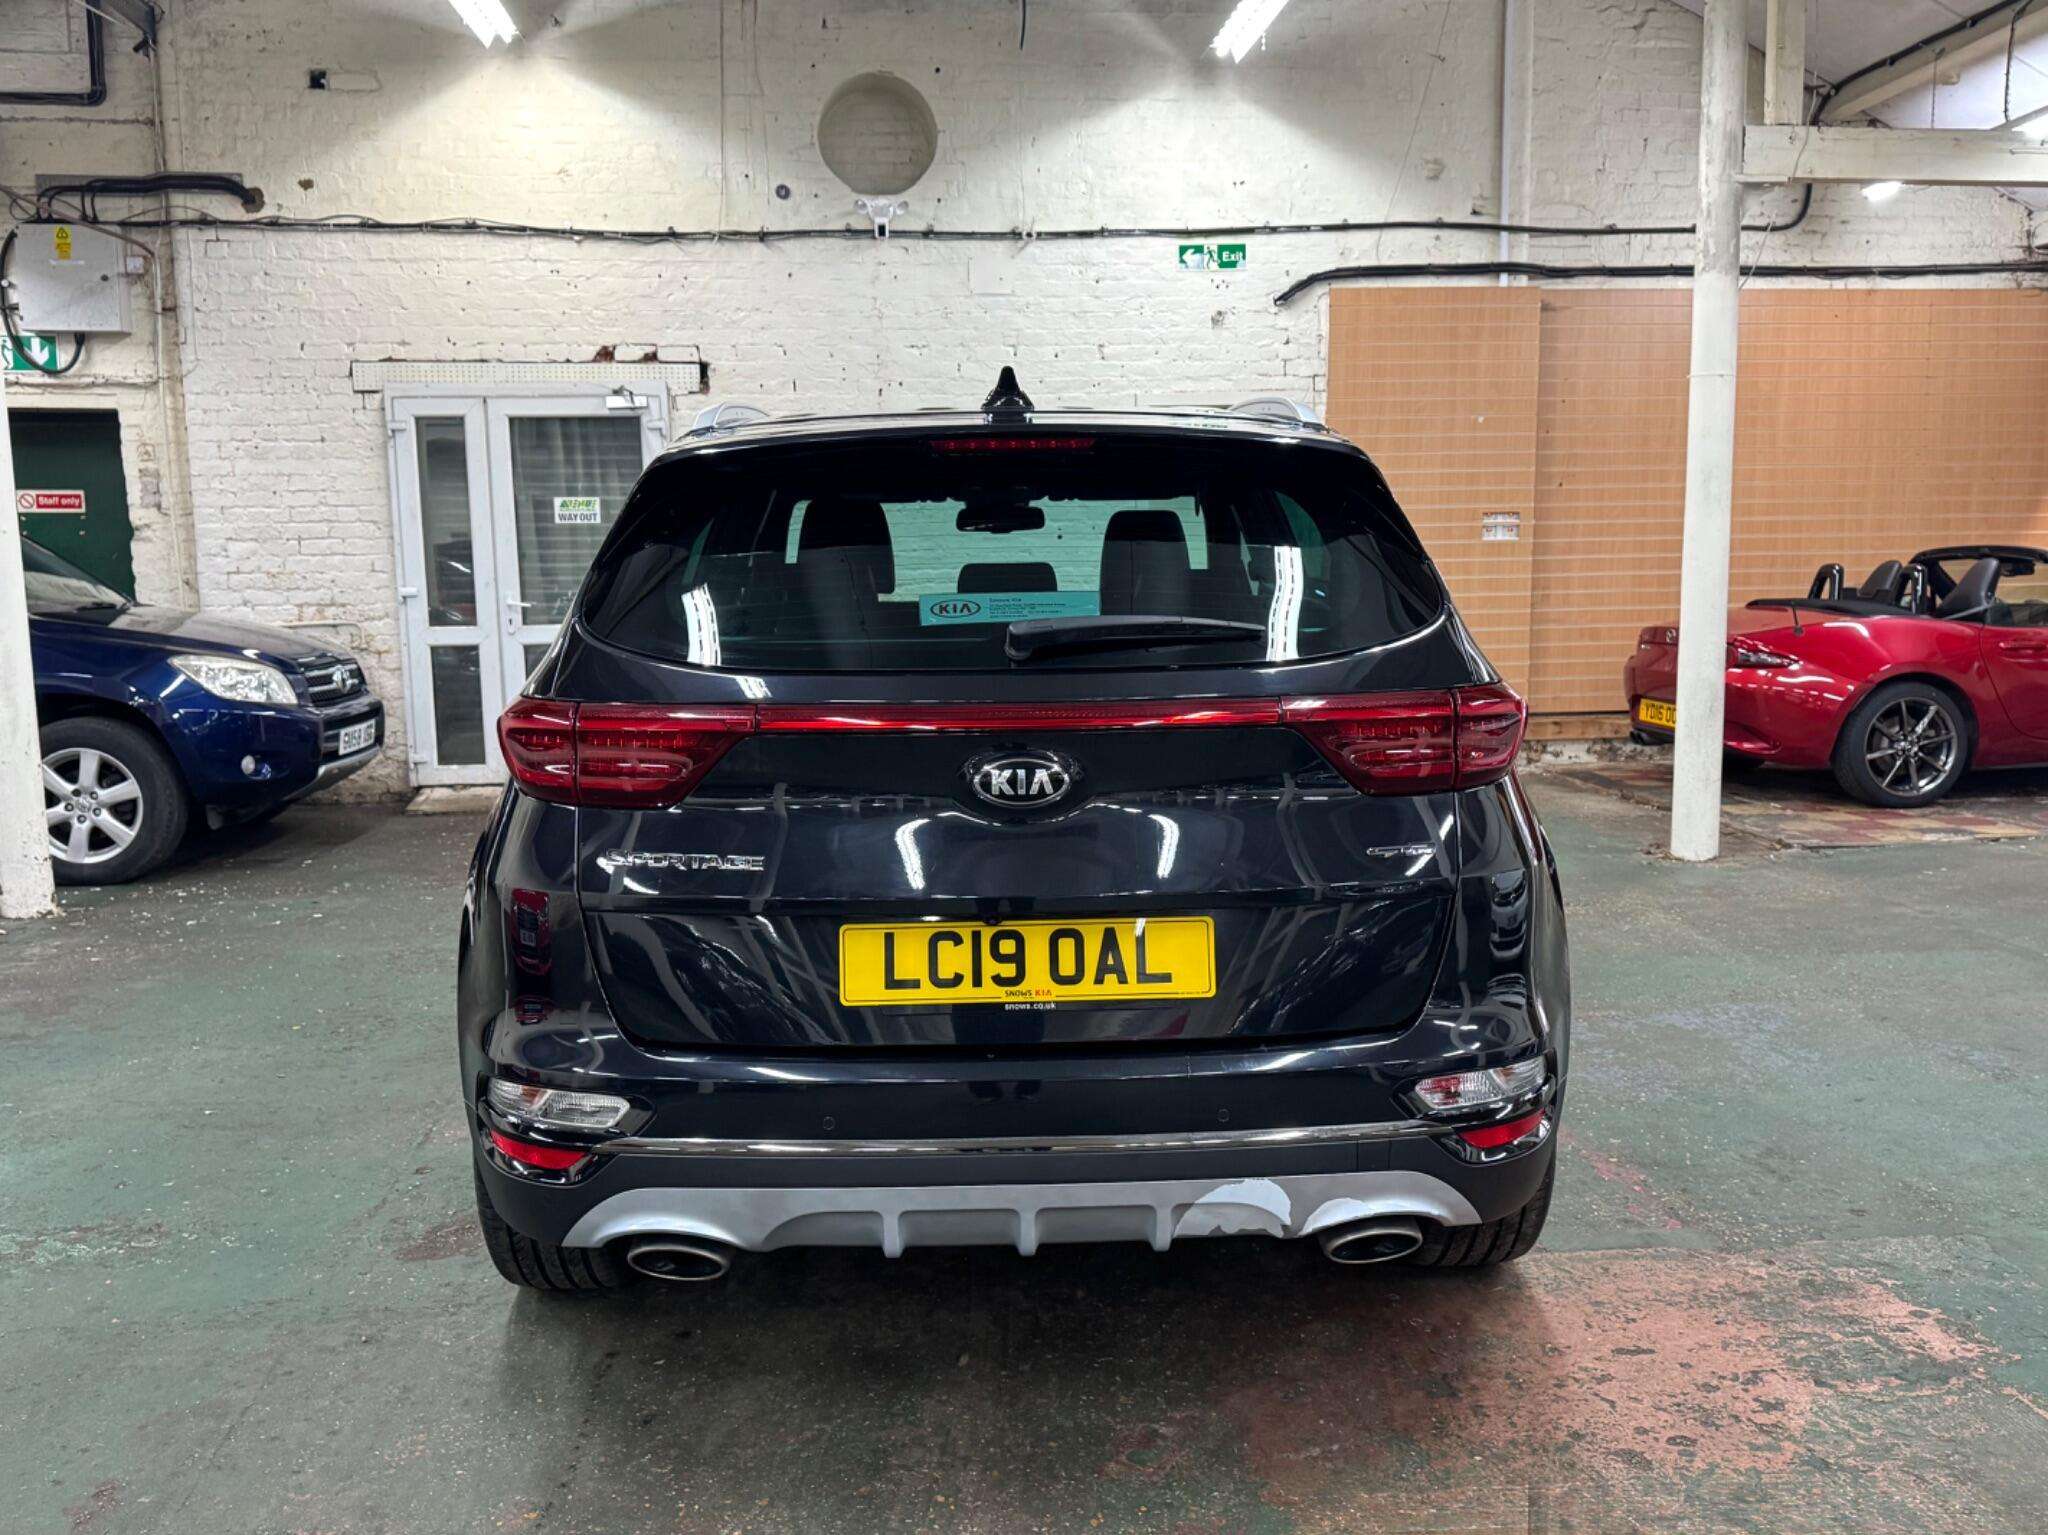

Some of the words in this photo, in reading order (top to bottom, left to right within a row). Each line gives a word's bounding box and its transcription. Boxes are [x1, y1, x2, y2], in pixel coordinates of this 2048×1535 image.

[1222, 251, 1243, 262] Exit
[38, 496, 60, 506] Staff
[61, 496, 80, 507] only
[558, 513, 578, 521] WAY
[579, 513, 598, 521] OUT
[939, 603, 973, 615] KIA
[990, 769, 1054, 795] KIA
[606, 850, 765, 871] SPORTAGE
[884, 928, 1026, 990] LC19
[1048, 927, 1173, 986] OAL
[1004, 989, 1032, 997] SNOWS
[1035, 988, 1052, 997] KIA
[1004, 1001, 1057, 1011] snows.co.uk
